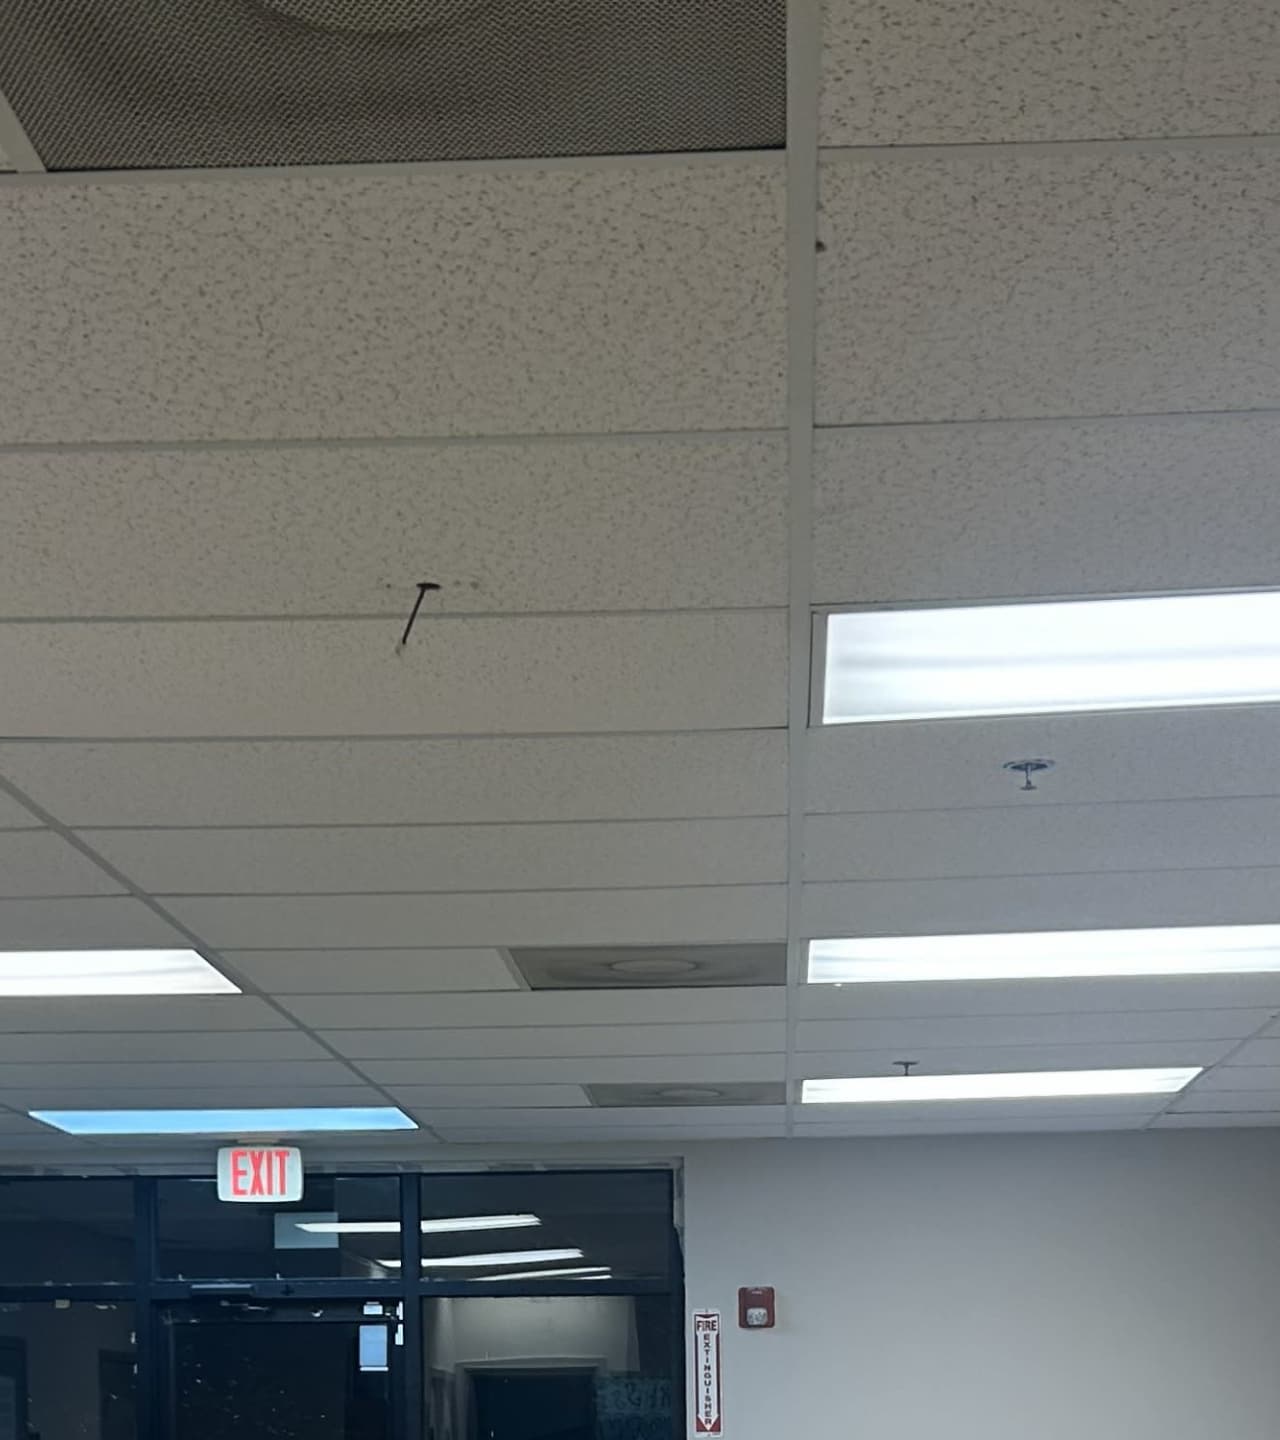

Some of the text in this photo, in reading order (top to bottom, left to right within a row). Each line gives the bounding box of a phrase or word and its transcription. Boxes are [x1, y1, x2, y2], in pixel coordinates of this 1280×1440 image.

[231, 1150, 290, 1196] EXIT
[696, 1320, 718, 1332] FIRE
[703, 1333, 713, 1426] EXTINGUISHER
